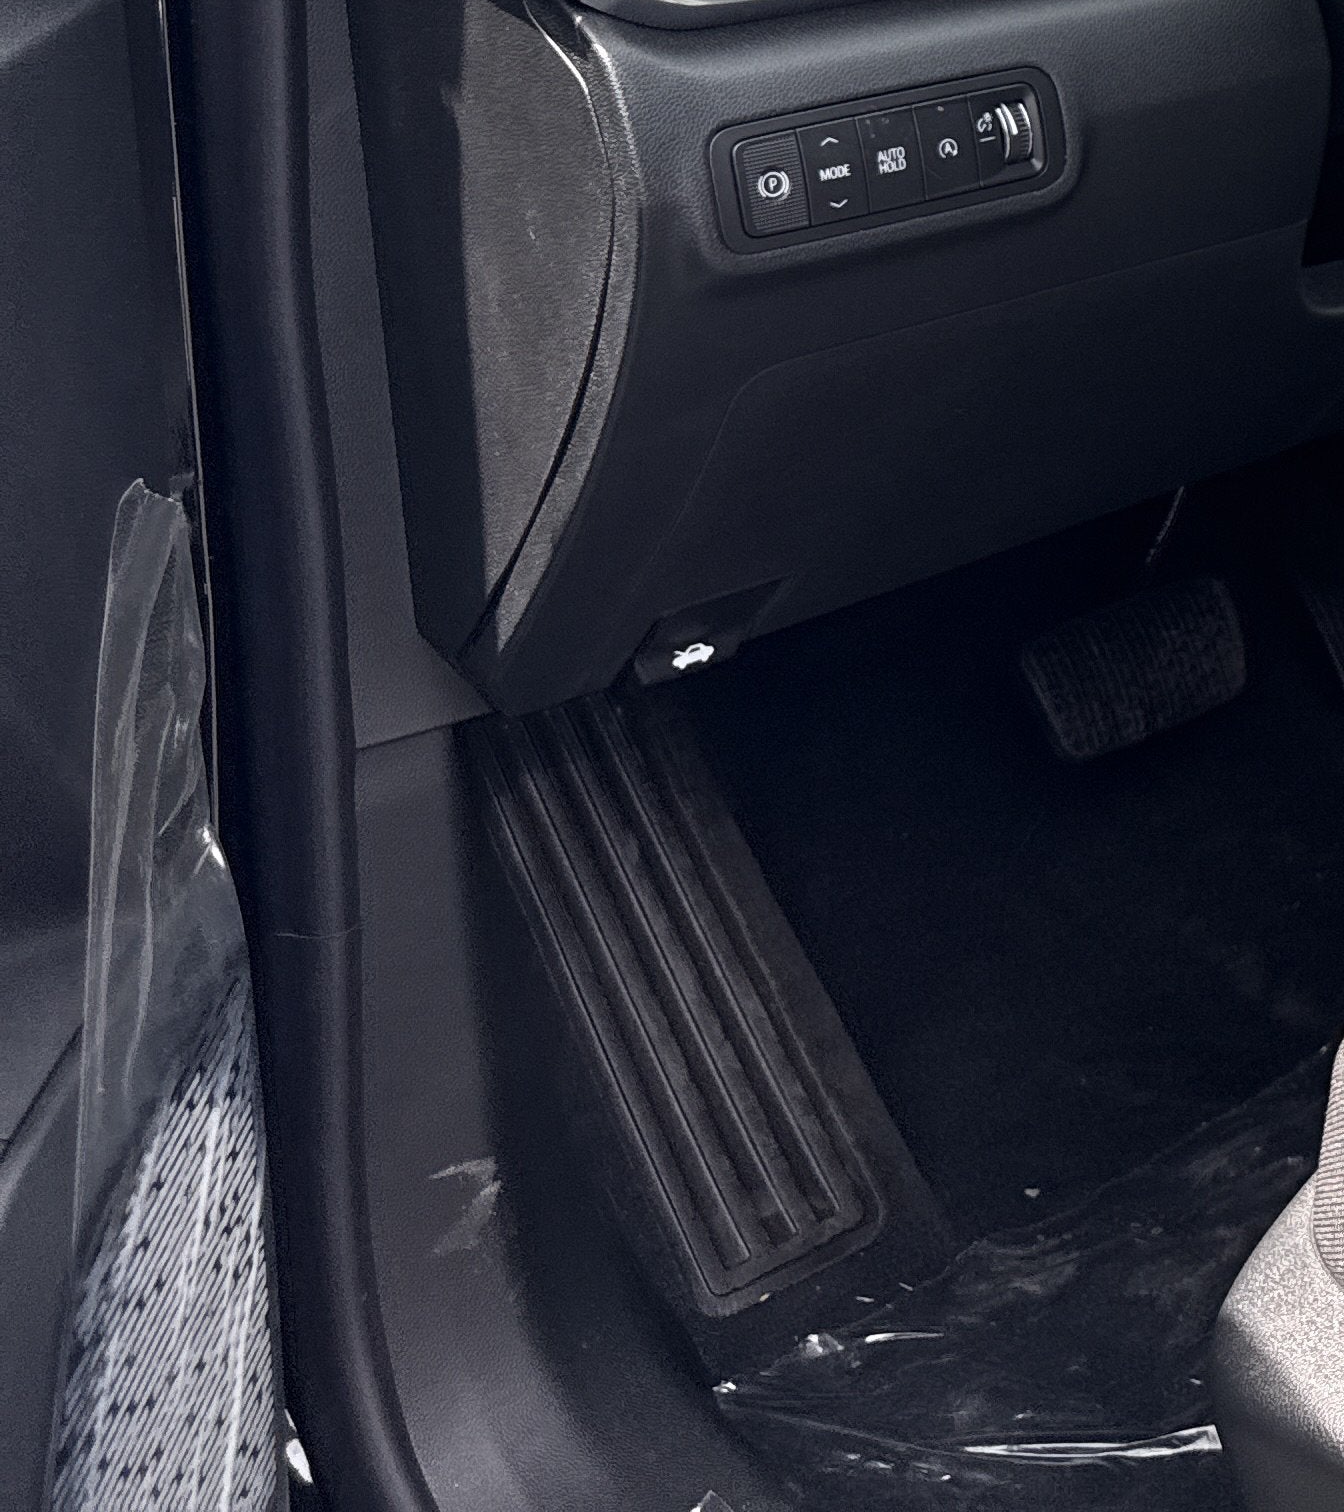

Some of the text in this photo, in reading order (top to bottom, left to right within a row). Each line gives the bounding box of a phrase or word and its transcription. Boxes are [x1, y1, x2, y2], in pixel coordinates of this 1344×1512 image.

[877, 145, 906, 162] AUTO
[819, 163, 852, 182] MODE
[878, 158, 907, 174] HOLD
